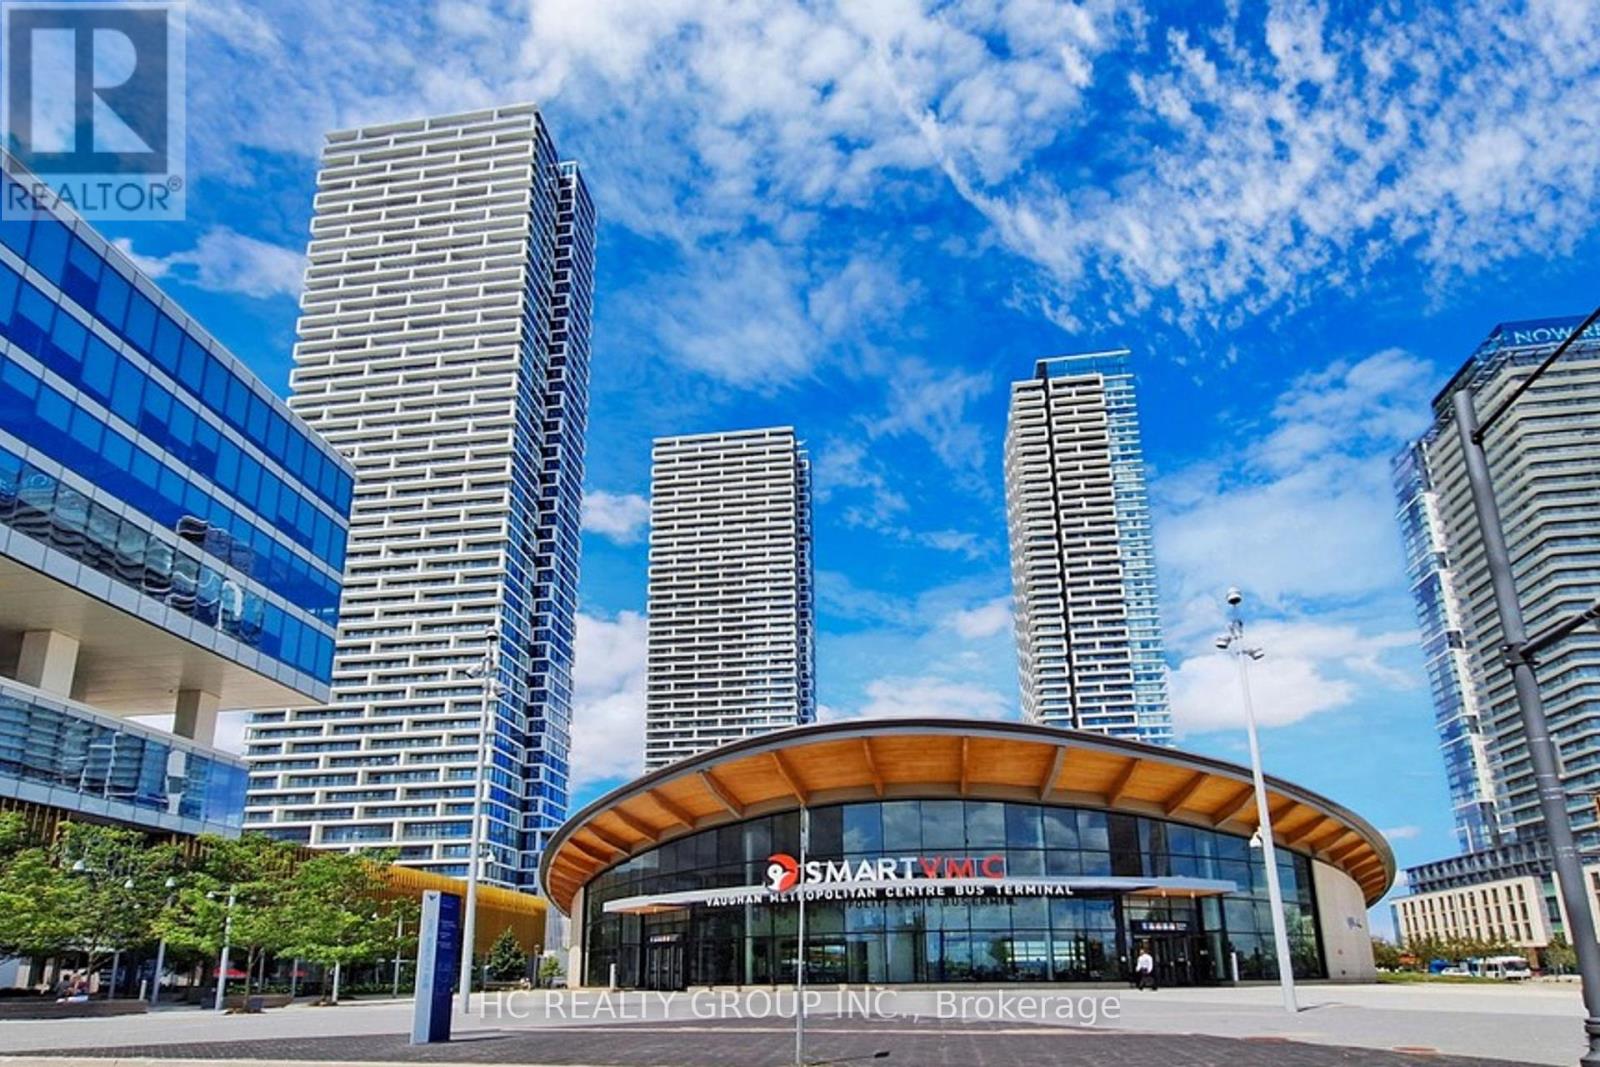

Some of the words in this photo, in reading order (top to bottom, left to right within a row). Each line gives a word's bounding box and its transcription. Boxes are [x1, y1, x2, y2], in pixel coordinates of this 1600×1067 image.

[1513, 326, 1573, 344] NOW
[885, 886, 945, 898] CENTRE
[955, 884, 984, 896] BUS
[996, 884, 1074, 895] TERMINAL
